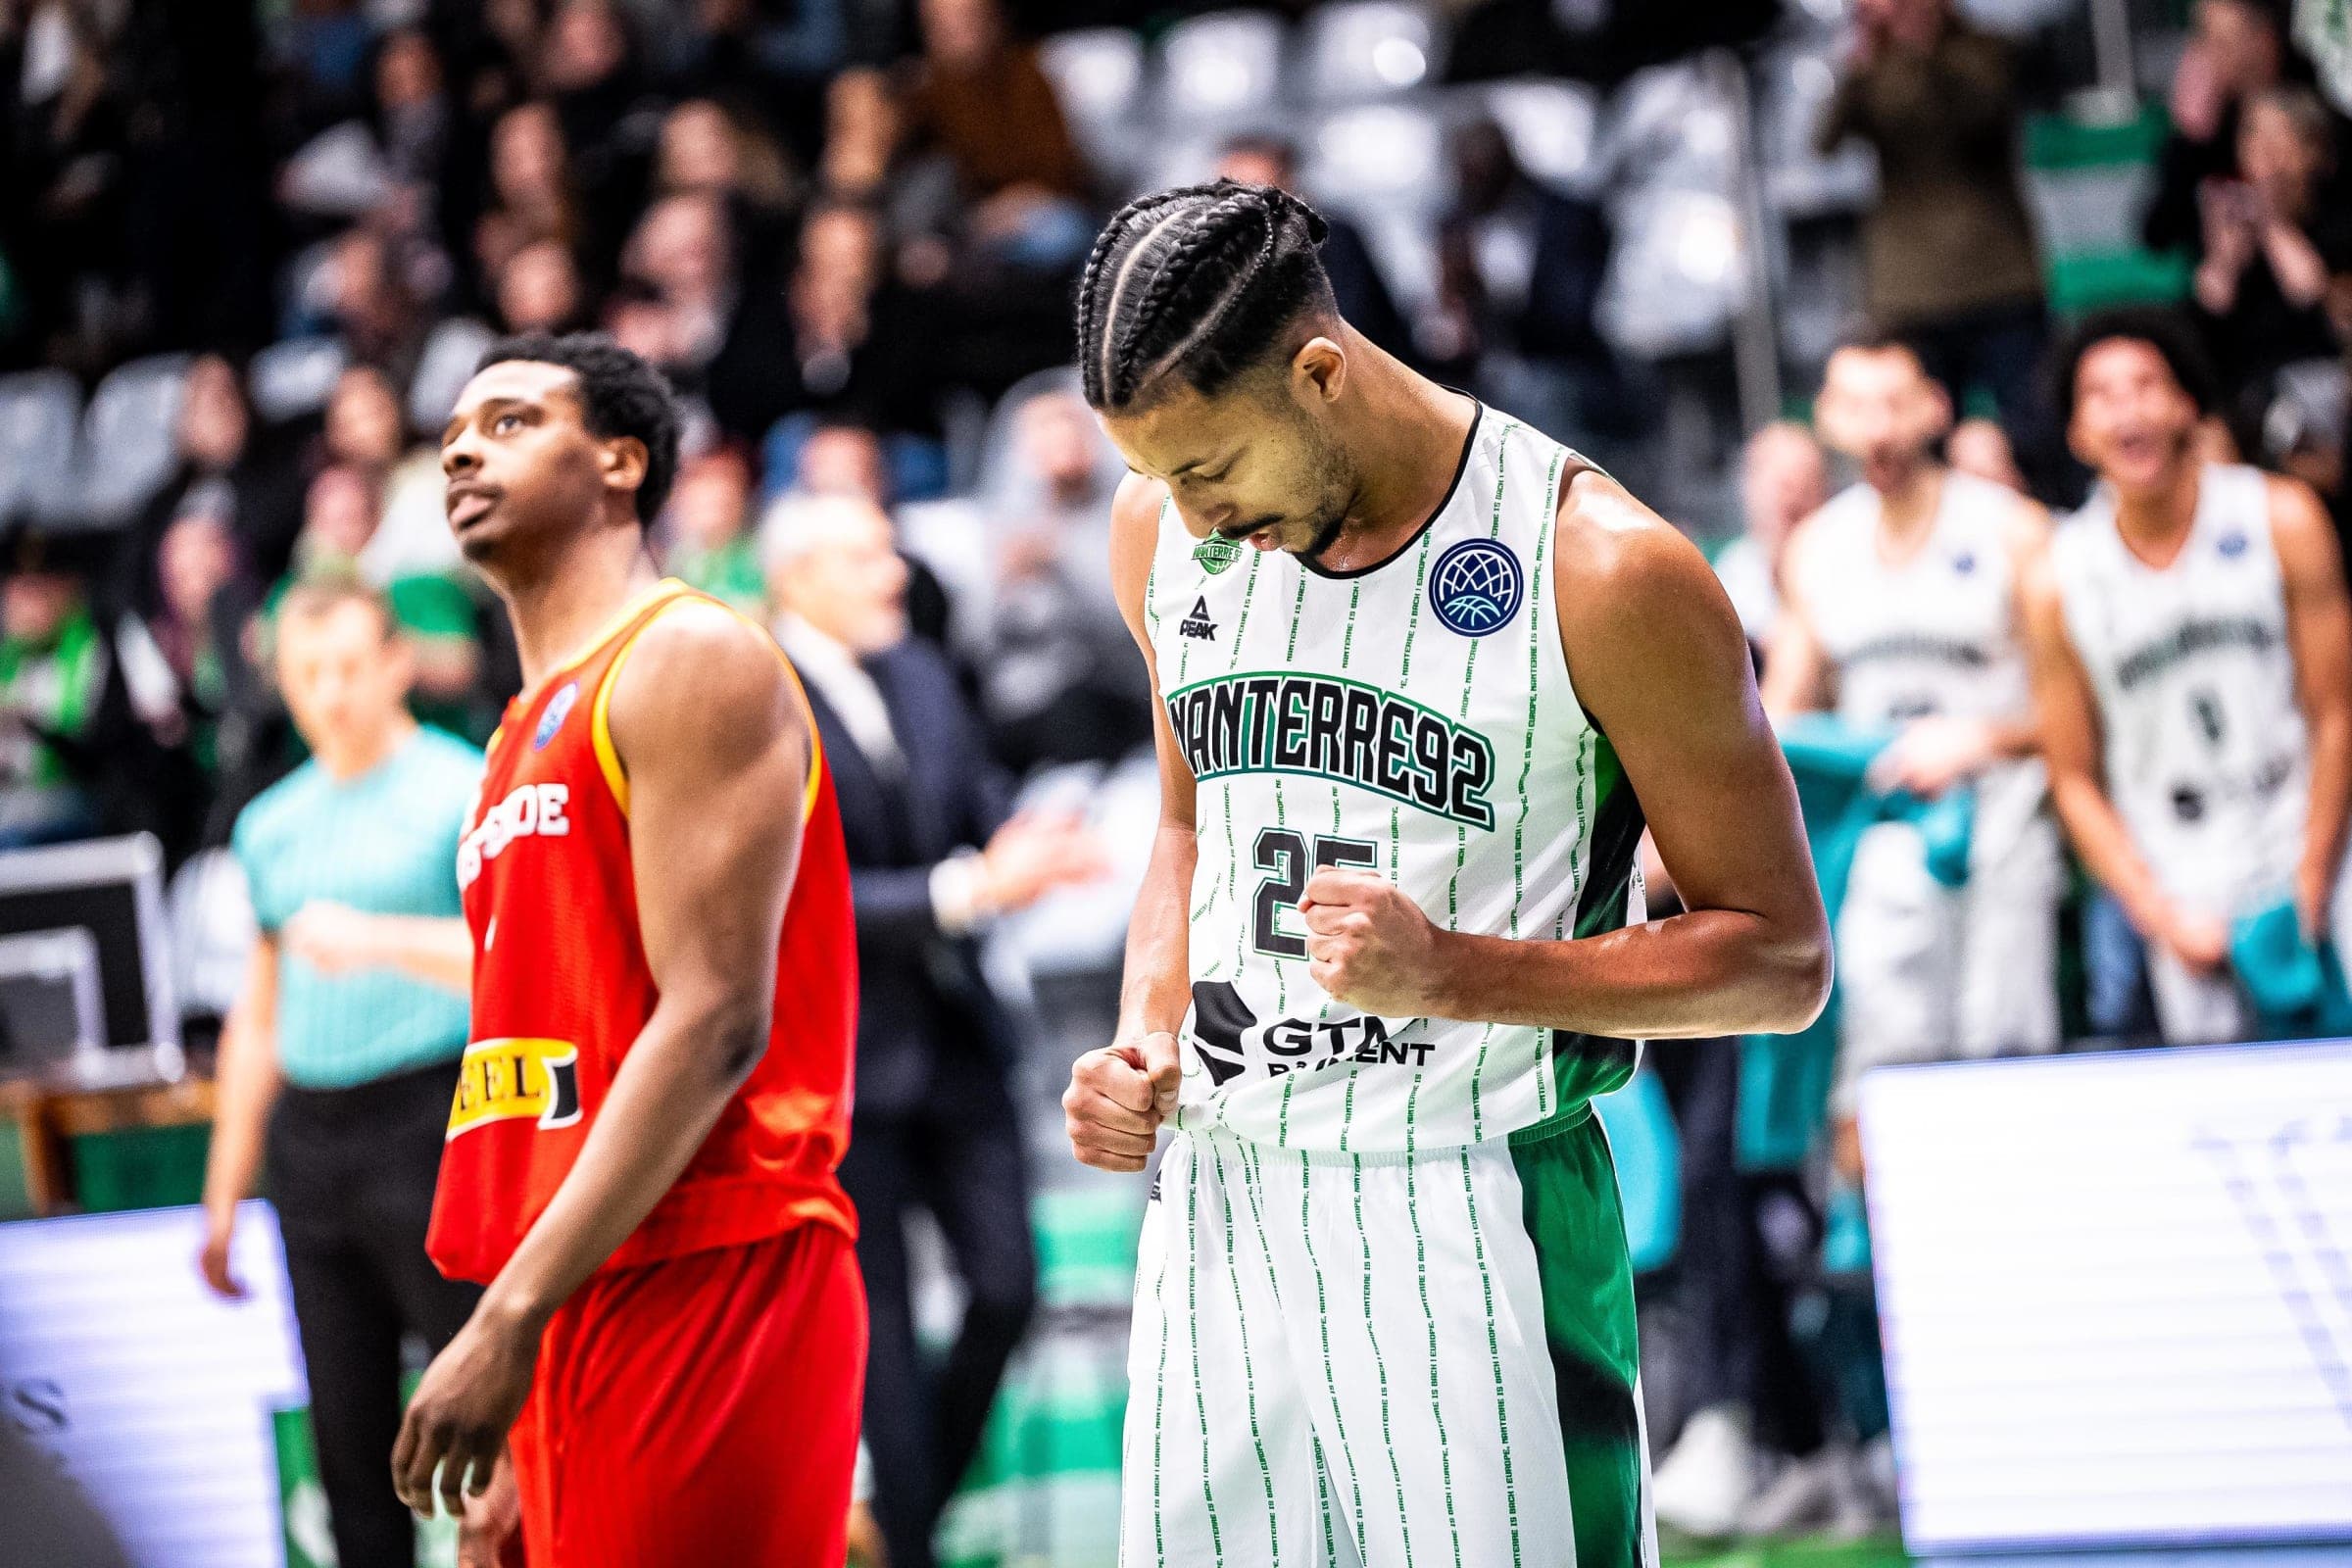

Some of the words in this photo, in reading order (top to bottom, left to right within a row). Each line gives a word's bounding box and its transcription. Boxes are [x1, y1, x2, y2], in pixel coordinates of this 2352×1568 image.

[1180, 618, 1218, 641] PEAK
[1401, 630, 1415, 675] NANTERRE
[1166, 671, 1496, 833] NANTERRE92
[1472, 1077, 1481, 1120] NANTERRE
[1418, 1275, 1433, 1318] NANTERRE
[1482, 1273, 1494, 1317] NANTERRE
[1249, 1394, 1259, 1437] NANTERRE
[1382, 1399, 1391, 1445] NANTERRE
[1432, 1401, 1447, 1446] NANTERRE
[1497, 1398, 1509, 1445] NANTERRE
[1154, 1511, 1163, 1554] NANTERRE
[1209, 1514, 1222, 1556] NANTERRE
[1269, 1512, 1278, 1556] NANTERRE
[1323, 1512, 1335, 1555] NANTERRE
